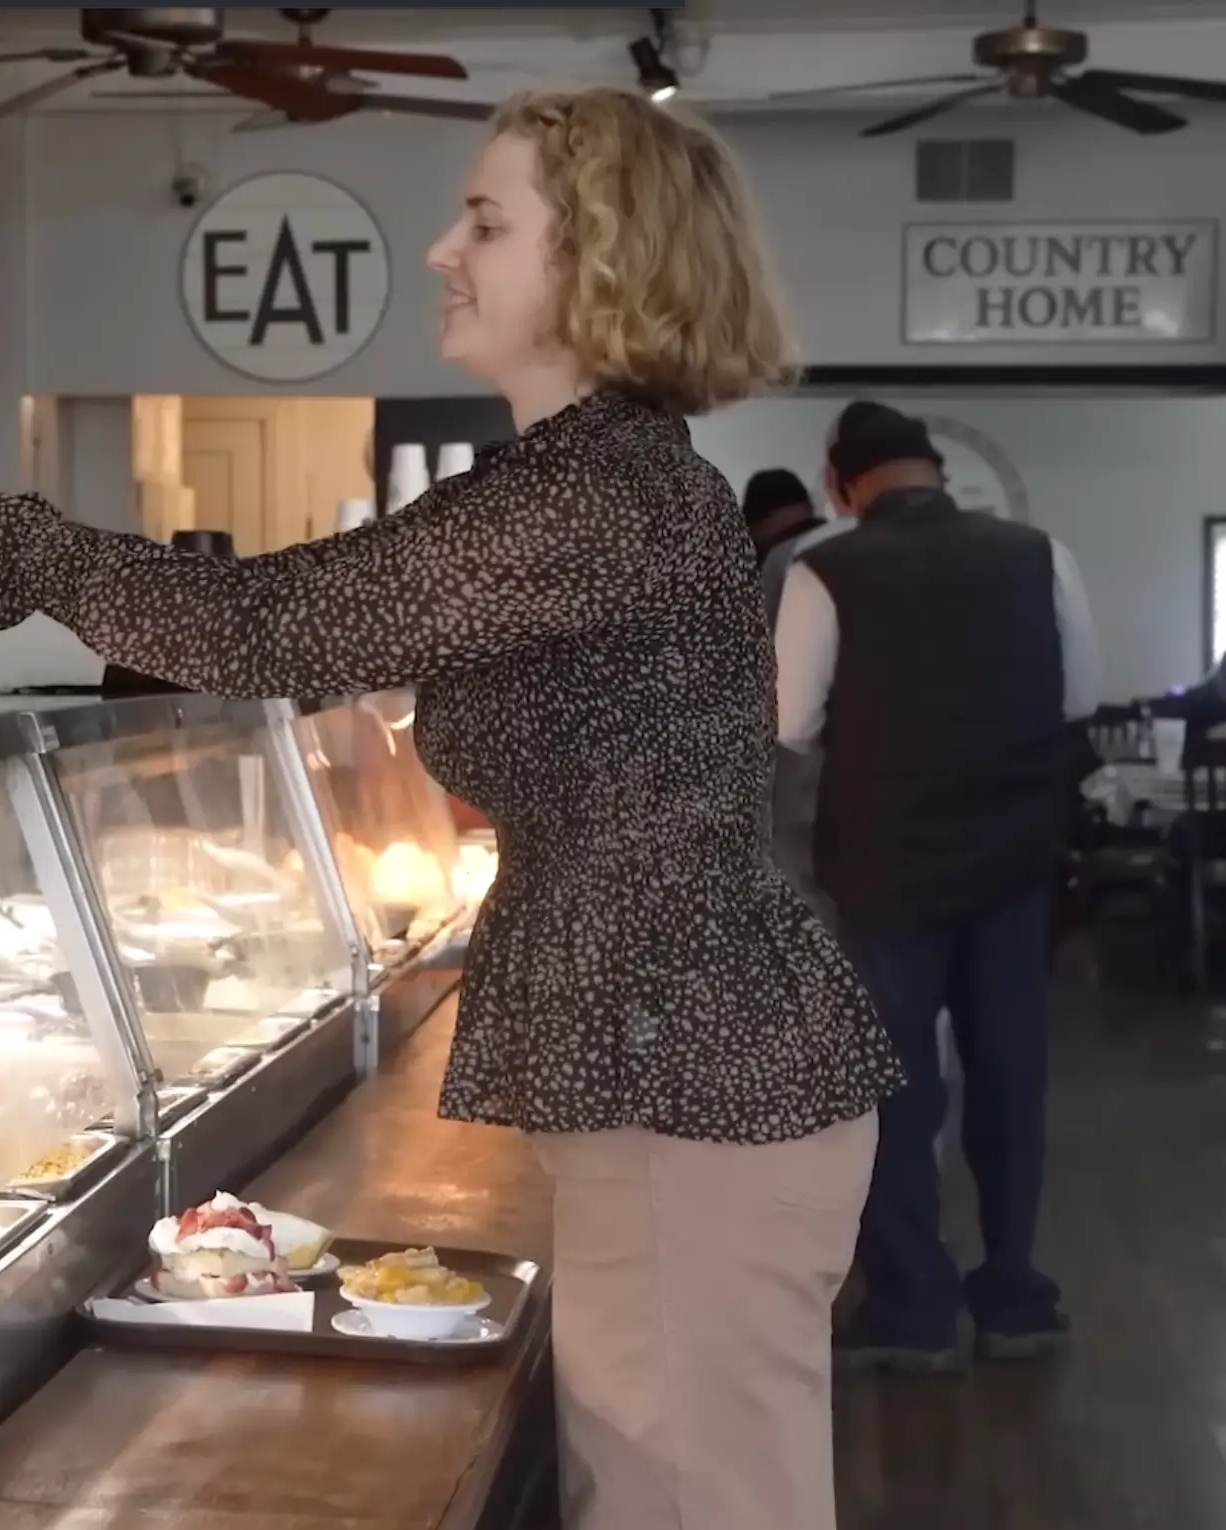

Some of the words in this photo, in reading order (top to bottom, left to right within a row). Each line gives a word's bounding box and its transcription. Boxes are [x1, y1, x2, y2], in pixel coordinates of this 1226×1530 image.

[923, 233, 1197, 278] COUNTRY
[203, 213, 371, 345] EAT
[976, 286, 1142, 328] HOME
